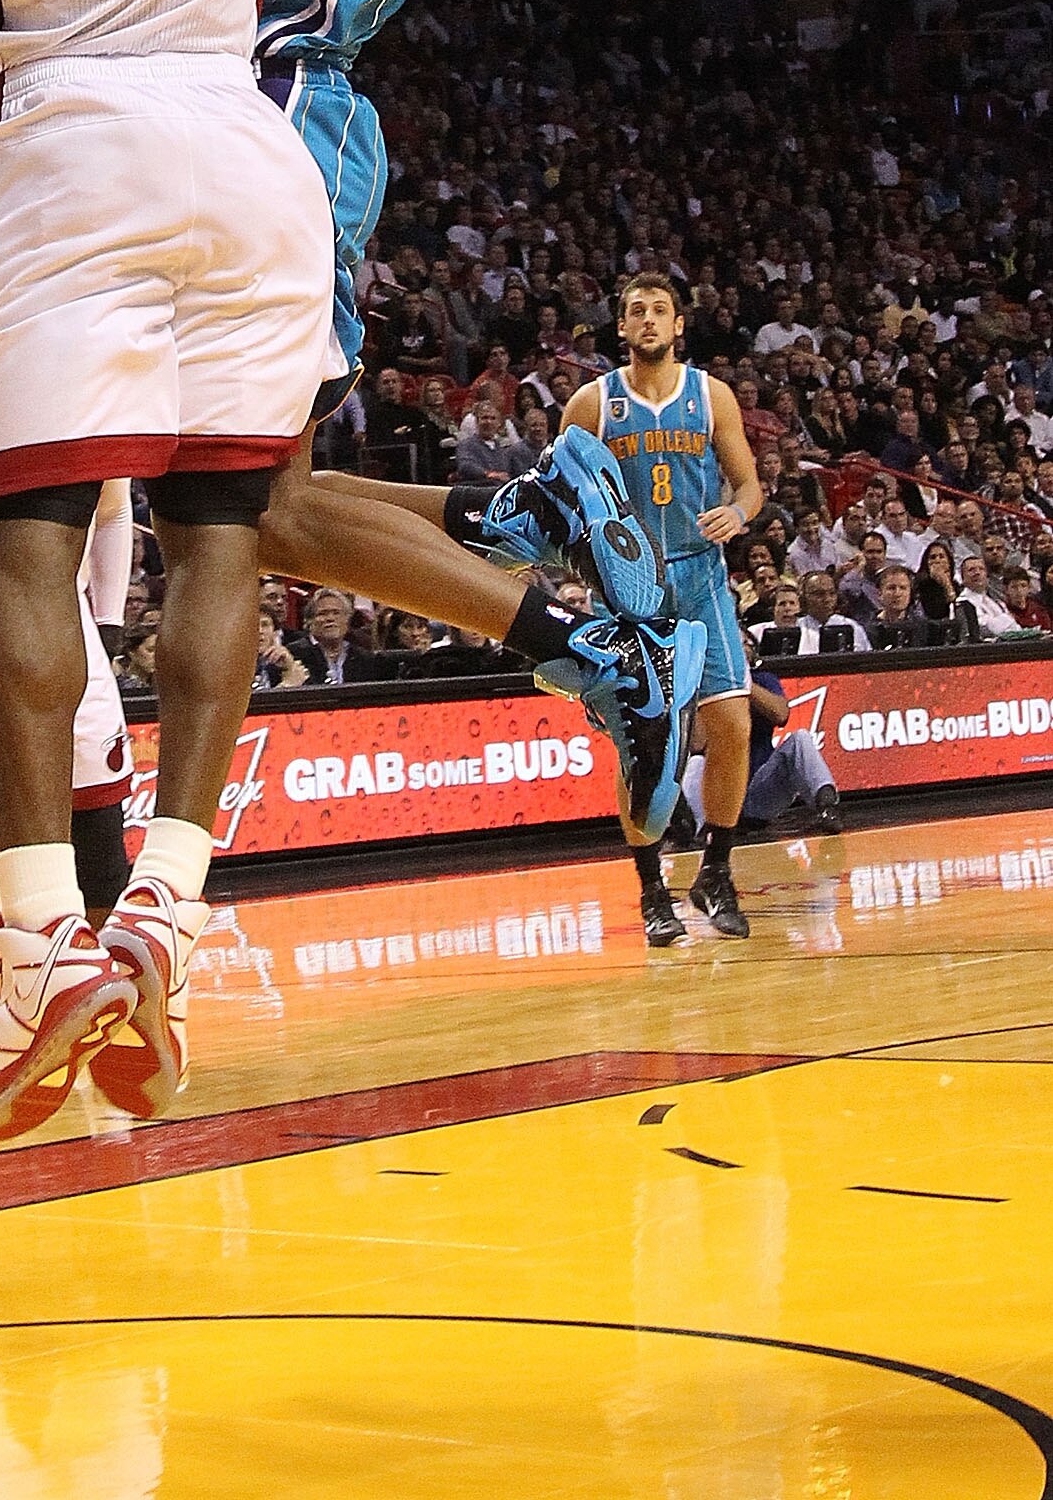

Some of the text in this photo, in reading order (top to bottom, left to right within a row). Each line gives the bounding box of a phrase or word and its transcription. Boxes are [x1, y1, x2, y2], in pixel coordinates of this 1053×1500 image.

[651, 463, 673, 506] 8
[838, 708, 931, 751] GRAB
[930, 714, 988, 743] SOME
[987, 698, 1053, 738] BUD
[283, 751, 406, 801] GRAB
[408, 757, 484, 790] SOME
[484, 736, 595, 785] BUDS
